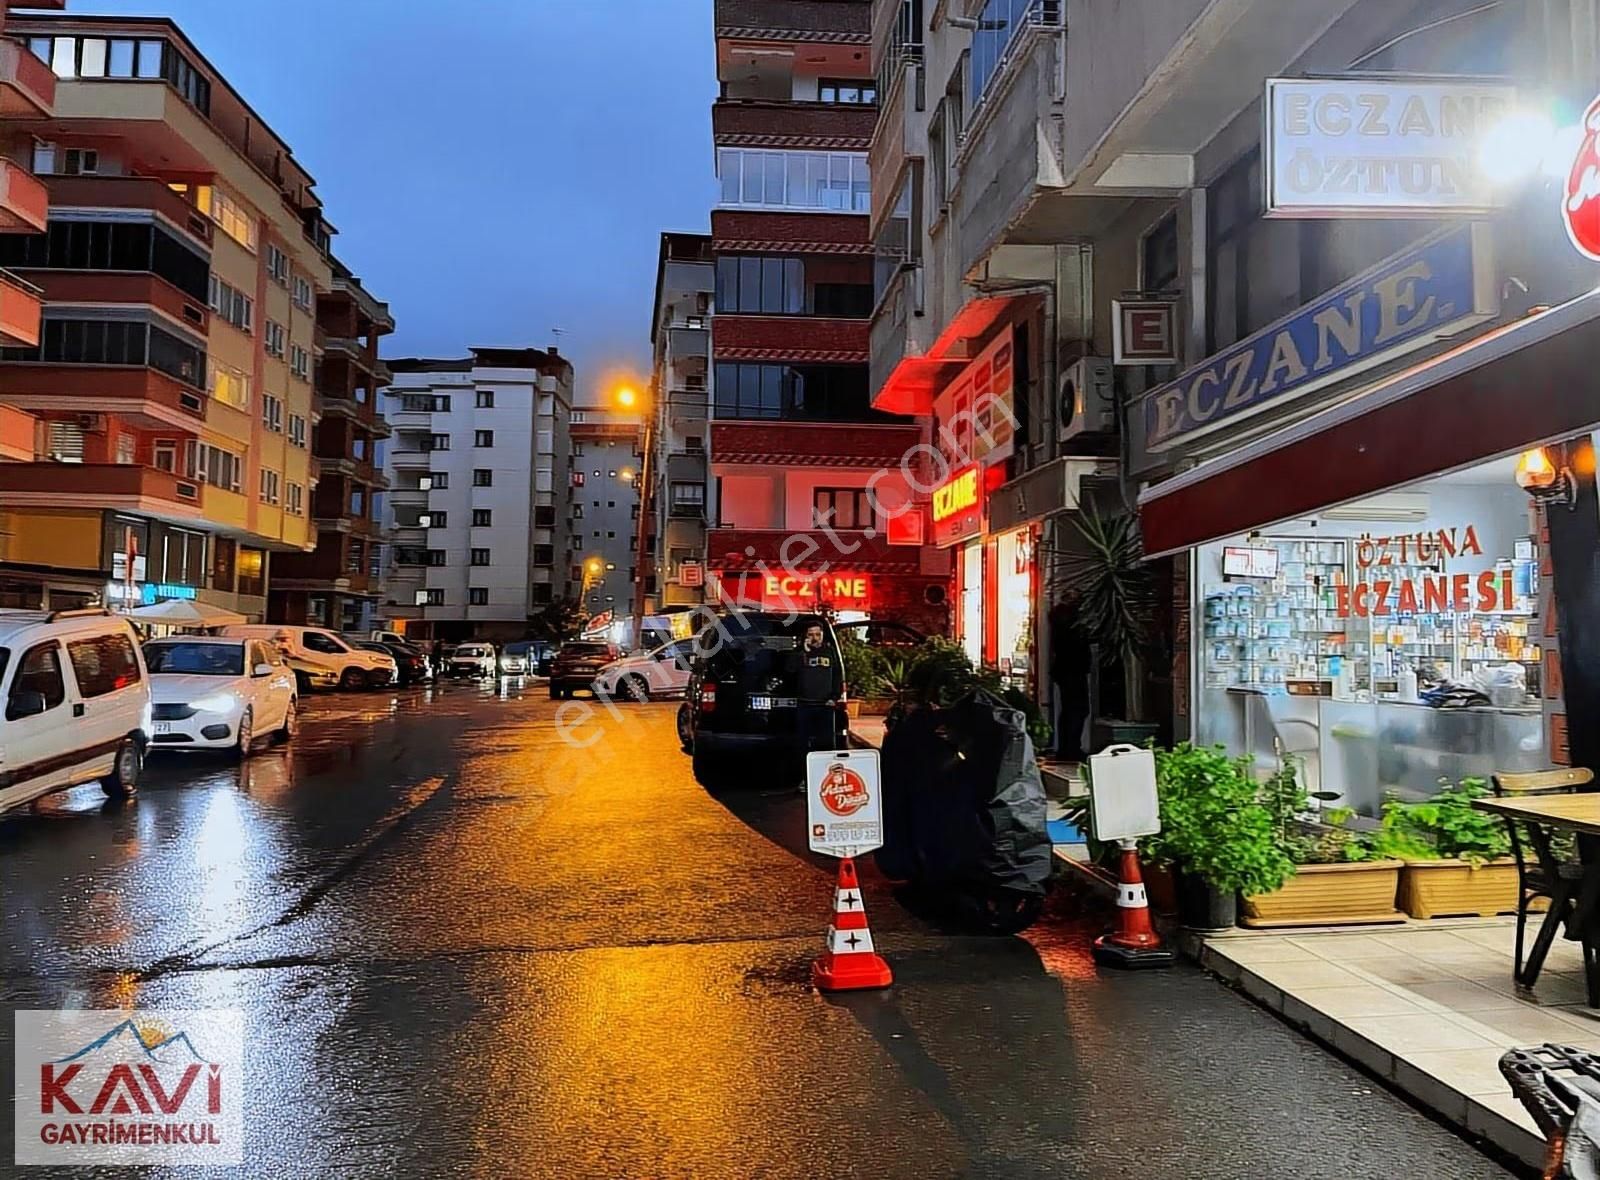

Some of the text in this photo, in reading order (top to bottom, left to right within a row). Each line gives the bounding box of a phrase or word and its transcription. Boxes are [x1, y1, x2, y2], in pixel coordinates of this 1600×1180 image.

[1131, 313, 1164, 350] E
[1358, 525, 1482, 568] ÖZTUNA
[1336, 570, 1513, 618] ECZANESİ
